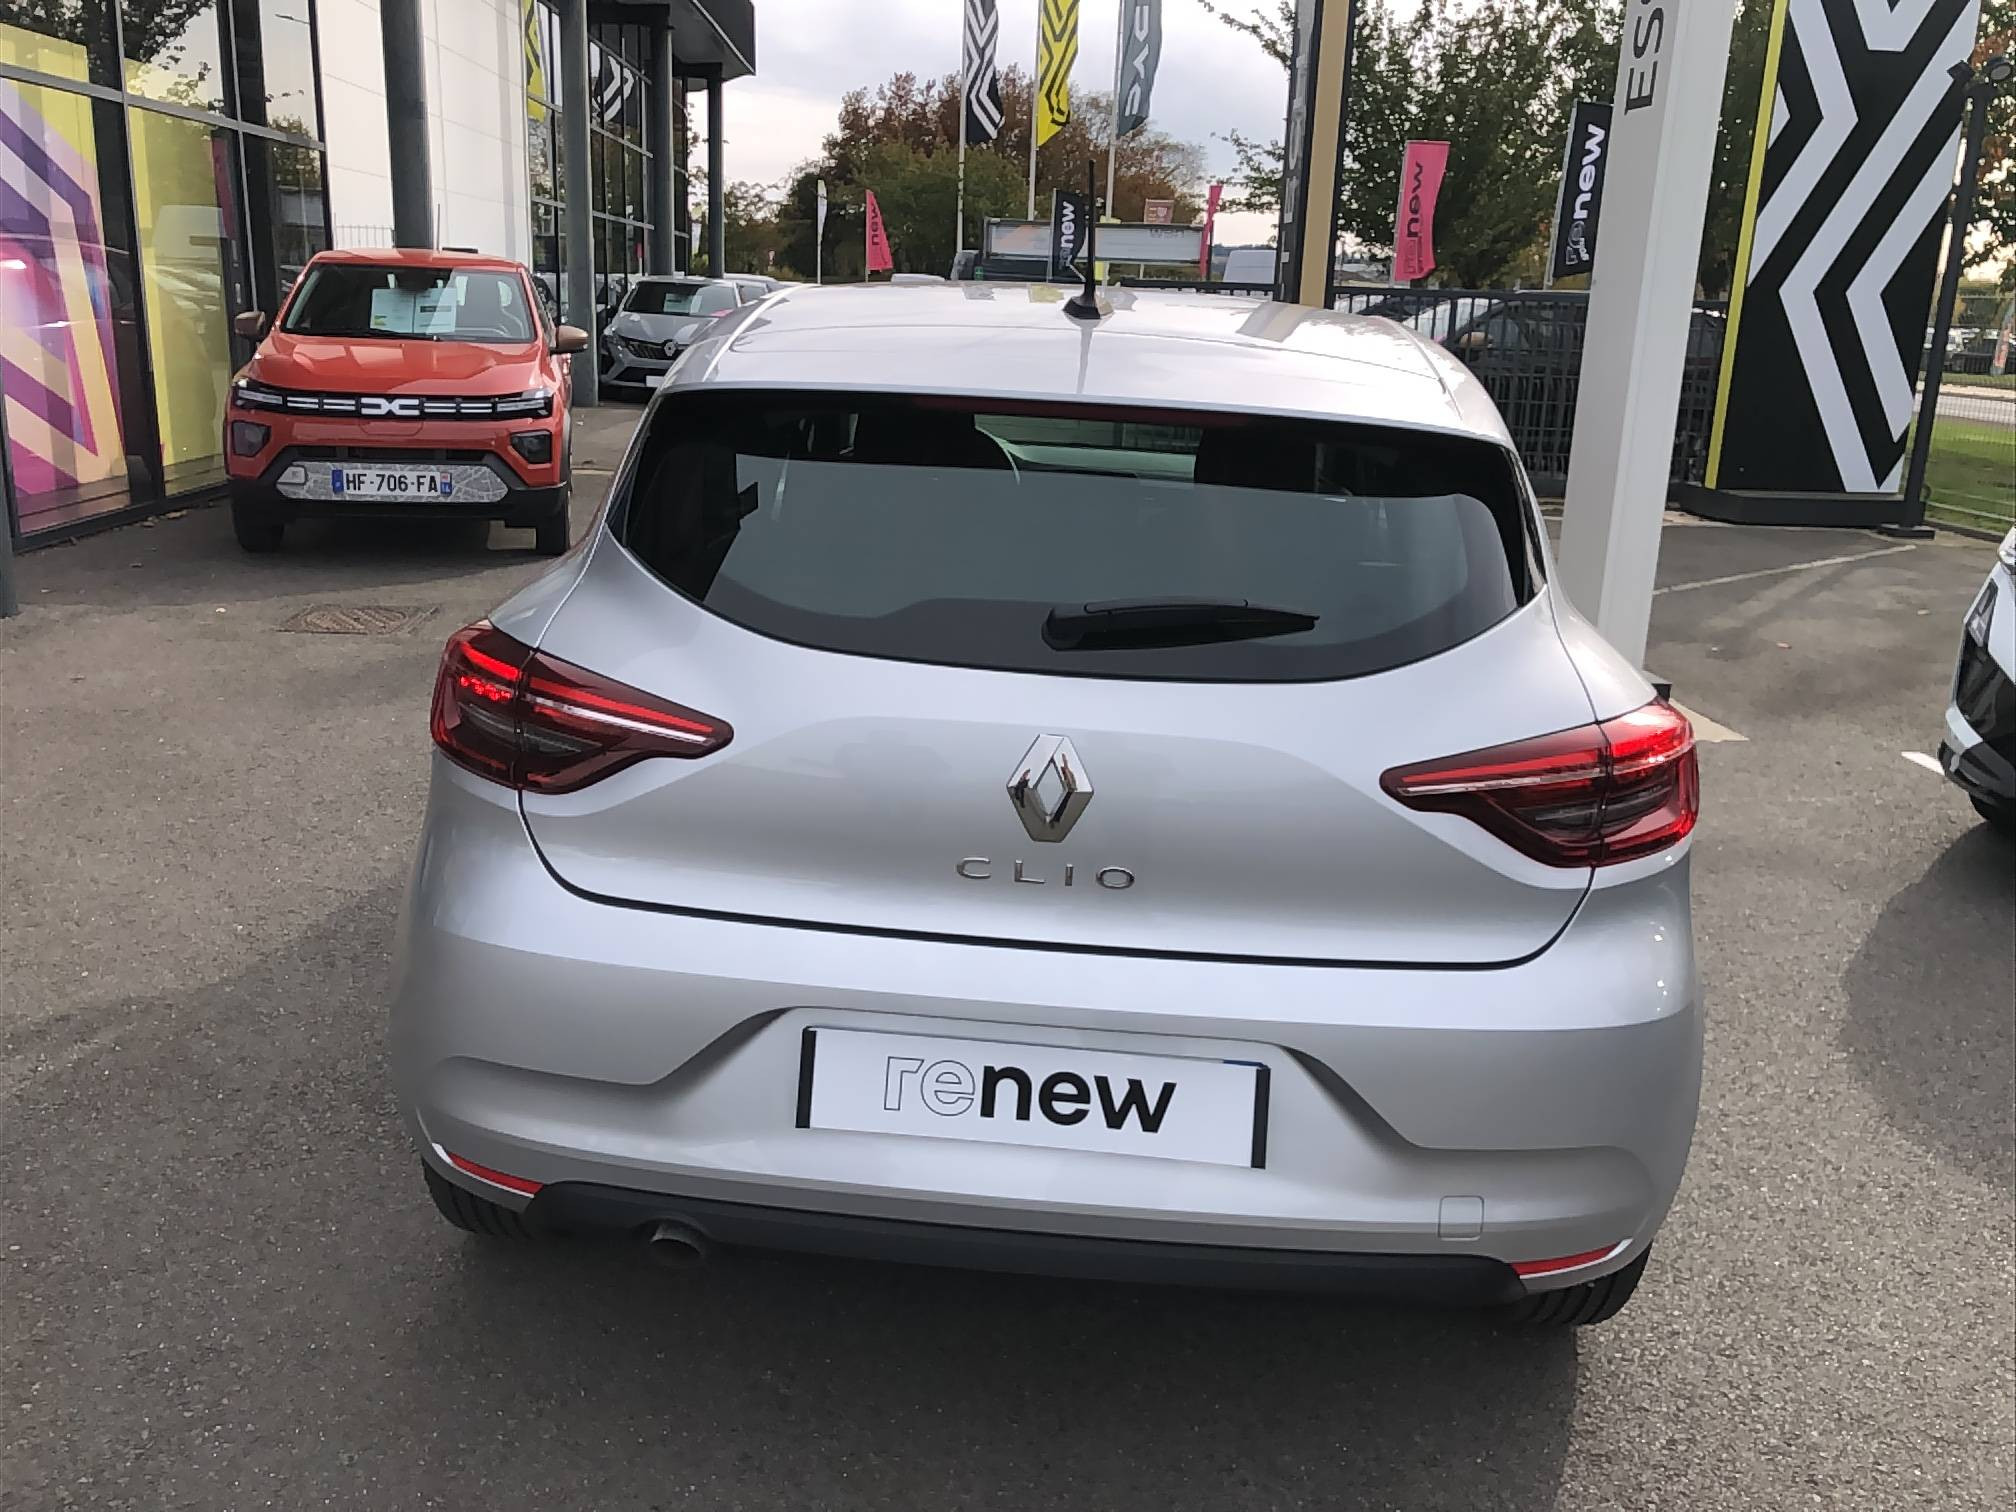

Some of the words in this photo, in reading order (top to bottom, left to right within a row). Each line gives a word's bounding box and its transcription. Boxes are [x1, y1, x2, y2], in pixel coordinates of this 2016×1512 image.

[1624, 0, 1664, 116] ES
[1565, 123, 1606, 265] renew
[345, 472, 438, 493] HF-706-FA
[956, 856, 1136, 890] CLIO
[883, 1055, 1178, 1133] renew
